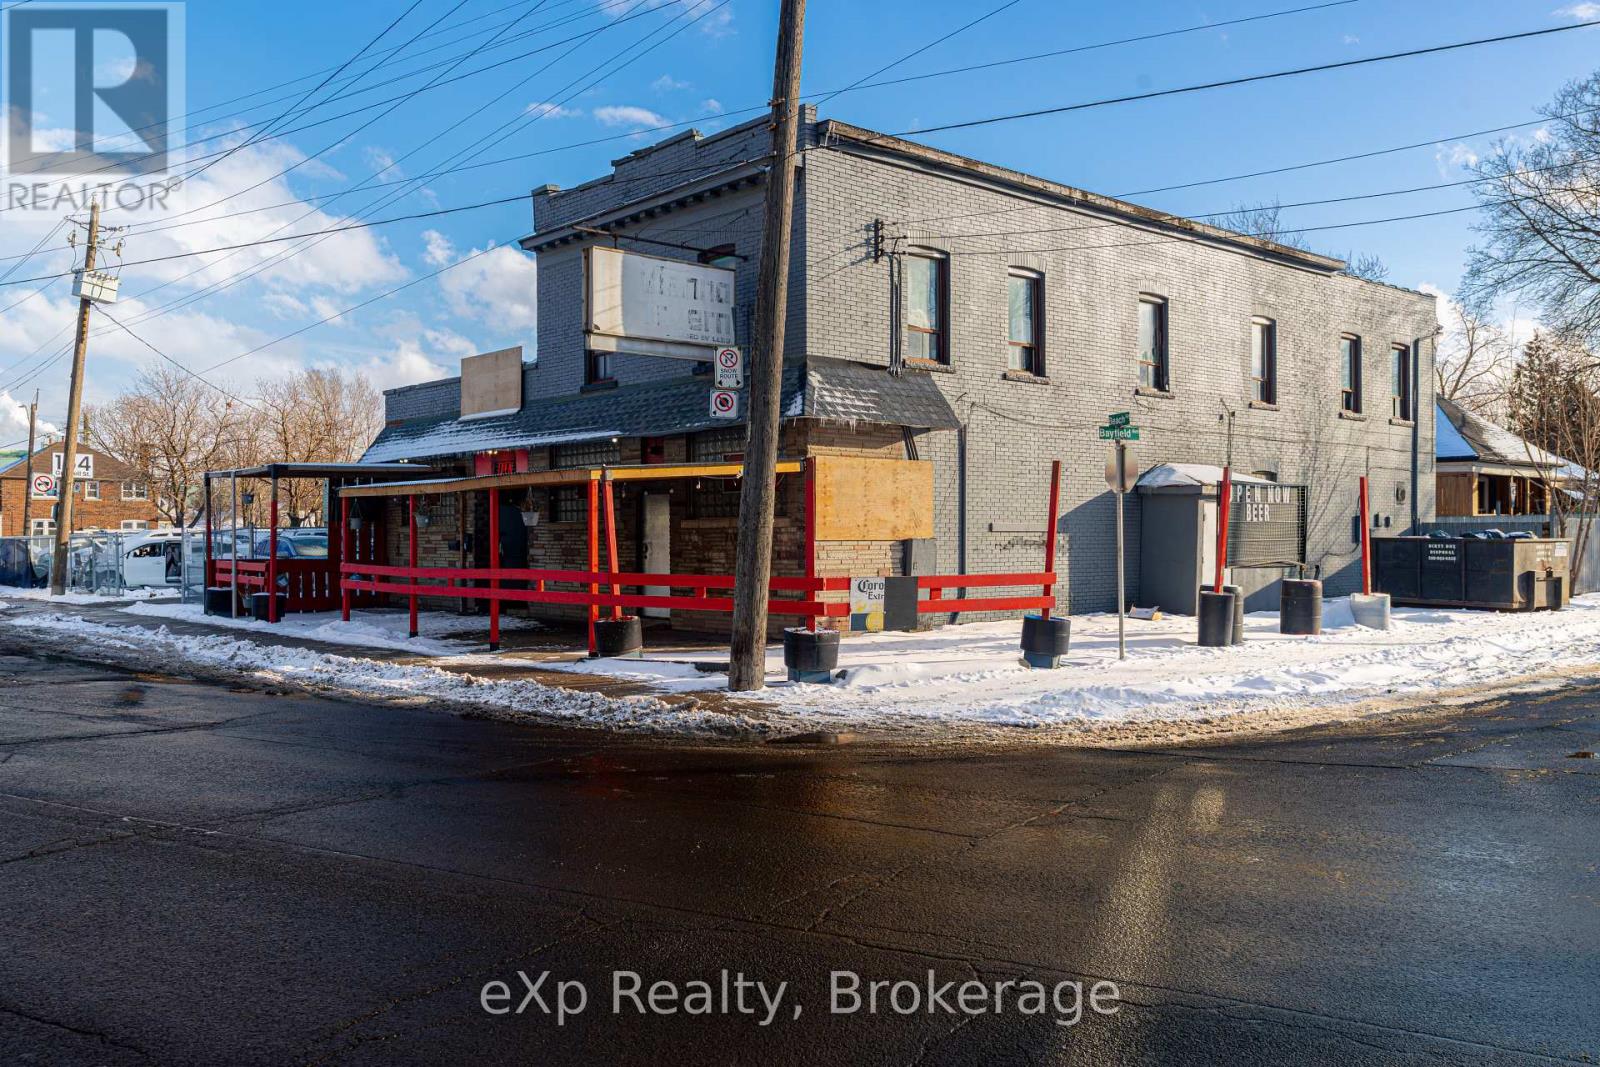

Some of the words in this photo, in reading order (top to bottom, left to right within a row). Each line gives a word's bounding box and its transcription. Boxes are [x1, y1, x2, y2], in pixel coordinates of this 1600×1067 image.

[1099, 428, 1132, 438] Bayfield
[55, 454, 91, 472] 14
[1229, 484, 1261, 503] PEN
[1267, 485, 1291, 503] NOW
[1246, 503, 1270, 522] BEER
